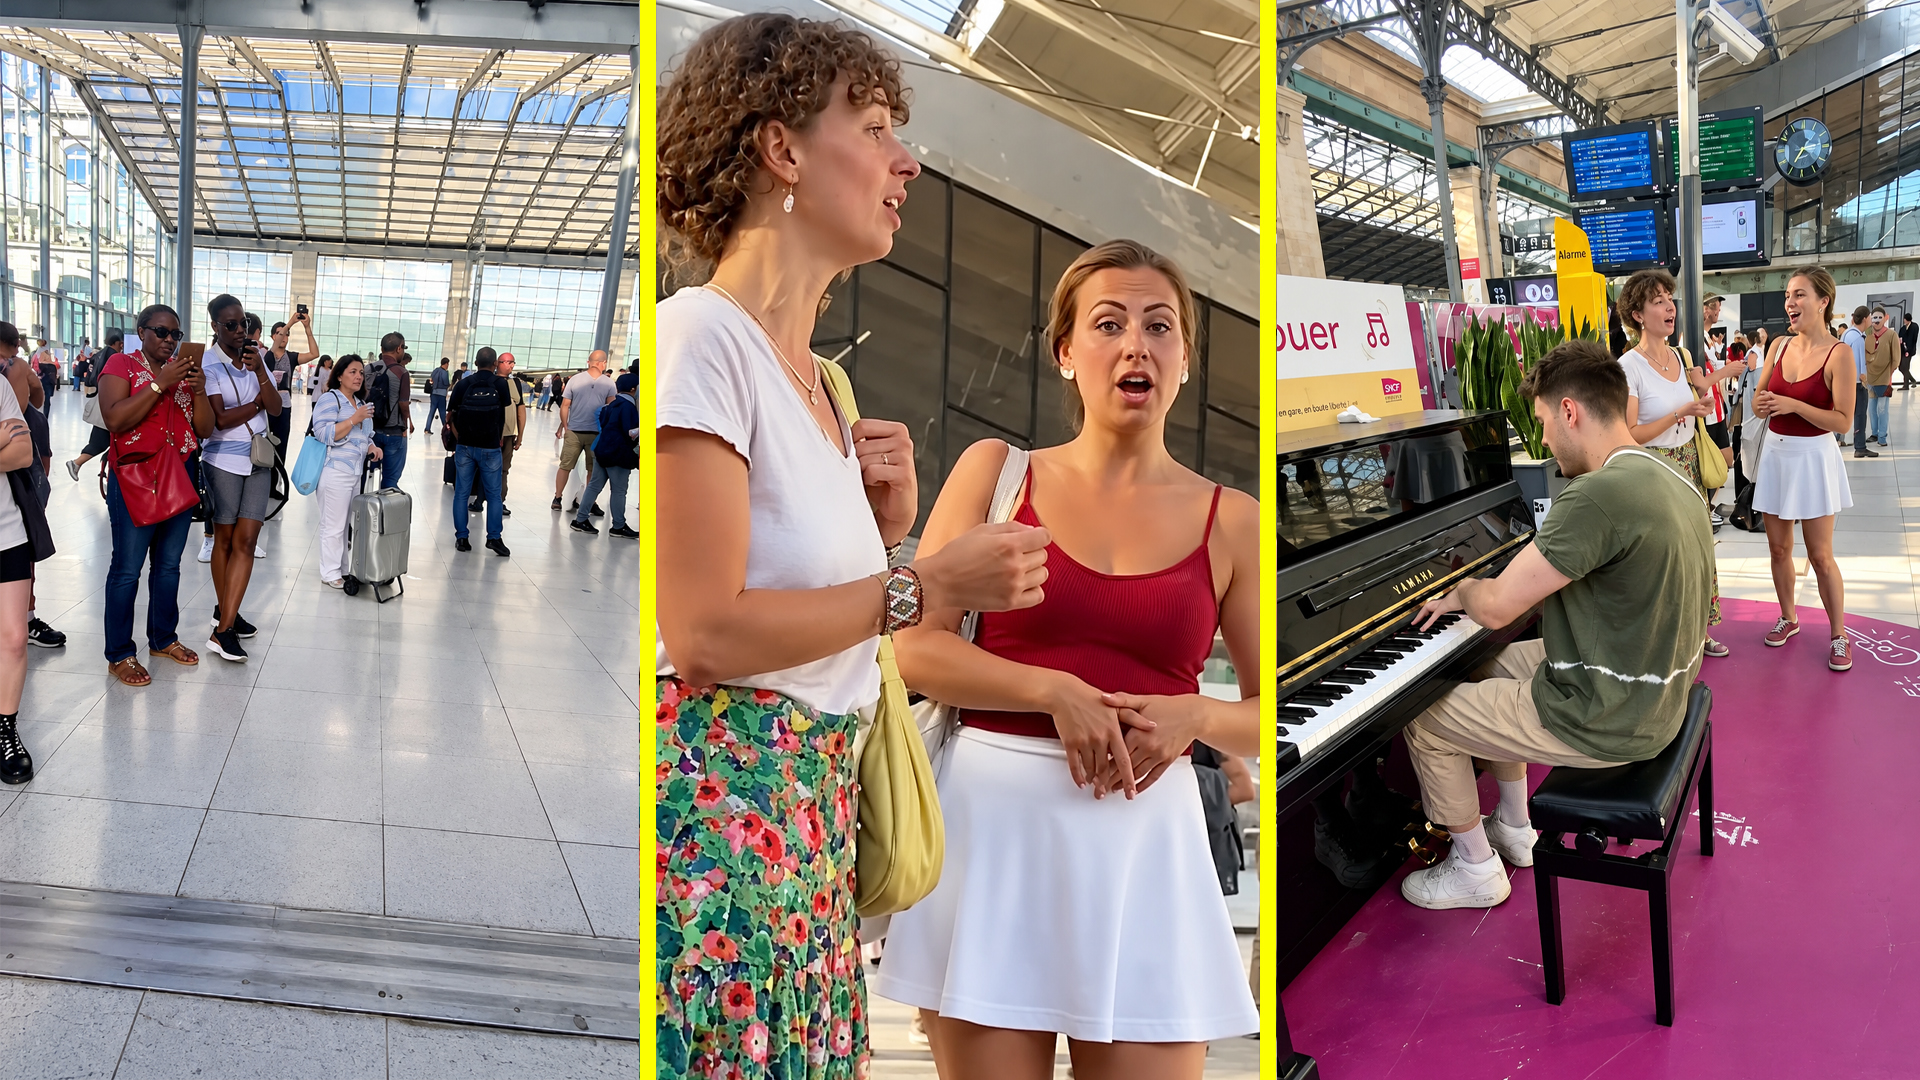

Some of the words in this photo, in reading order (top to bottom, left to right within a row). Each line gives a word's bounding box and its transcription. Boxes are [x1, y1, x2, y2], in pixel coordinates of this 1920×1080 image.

[1558, 249, 1587, 260] Alarme
[1384, 382, 1400, 393] SNCF
[1287, 408, 1304, 418] gare,
[1303, 406, 1312, 414] en
[1392, 569, 1434, 594] YAMAHA
